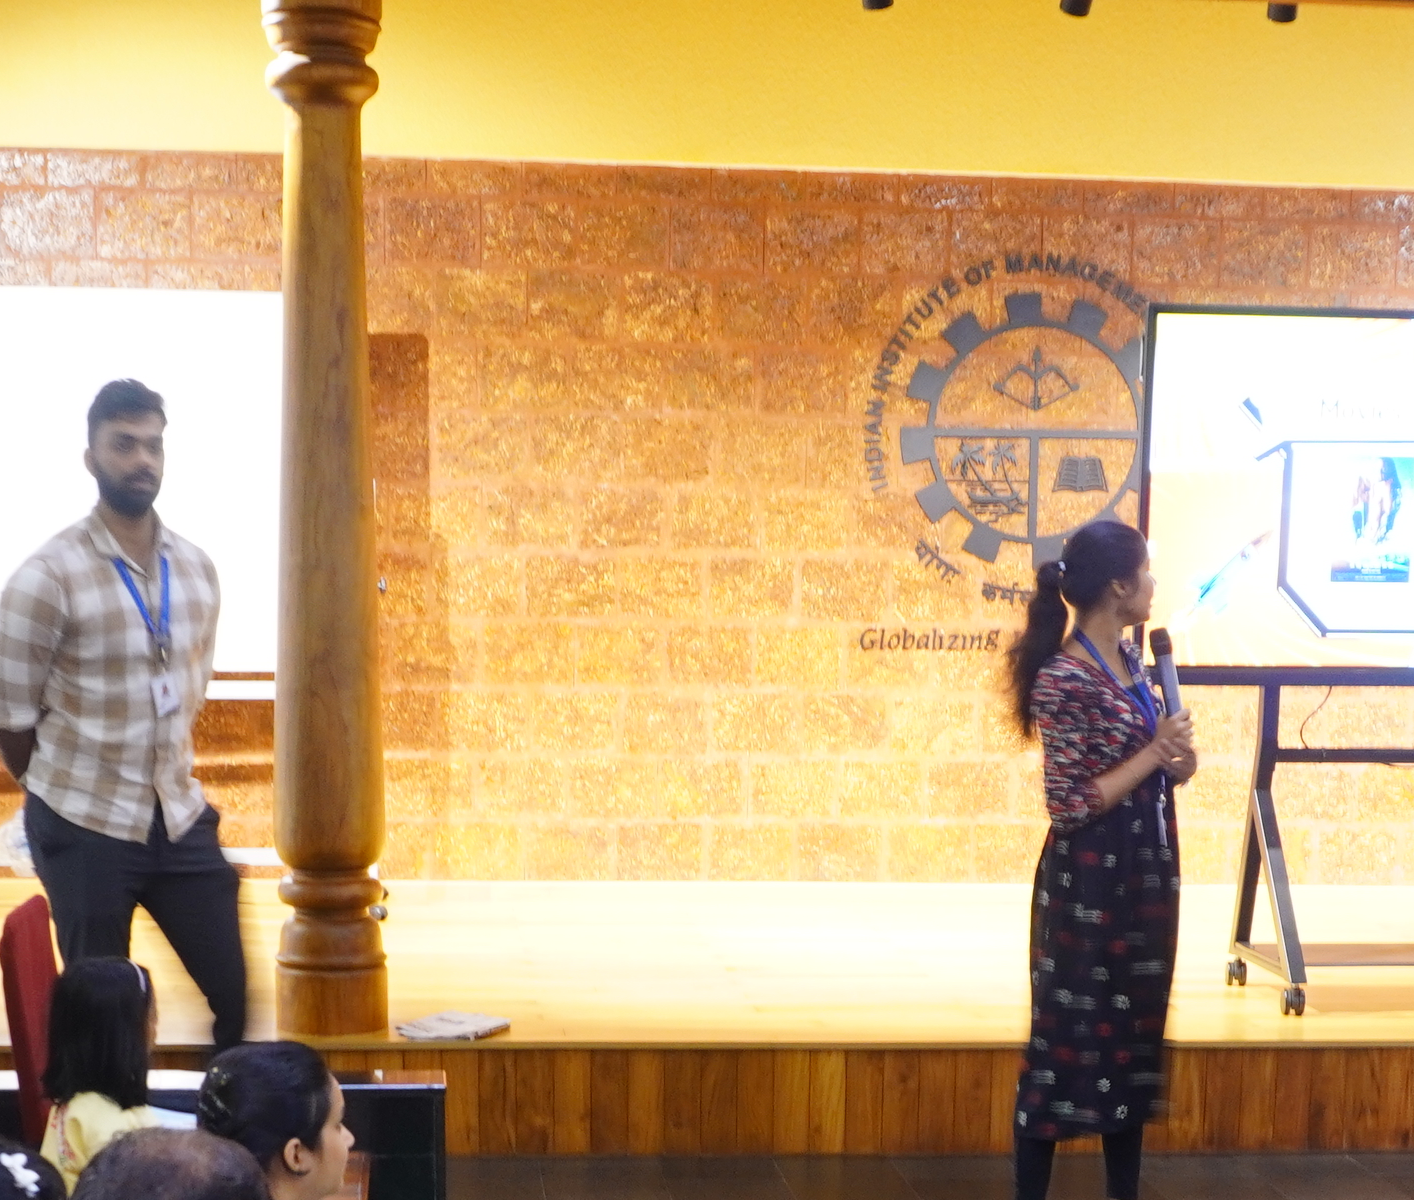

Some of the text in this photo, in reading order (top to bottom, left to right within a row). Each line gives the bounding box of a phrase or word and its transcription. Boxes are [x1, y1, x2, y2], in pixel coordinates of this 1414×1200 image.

[864, 253, 1148, 491] INDIAN INSTITUTE OF MANAGEME
[1320, 398, 1401, 420] Movie
[859, 628, 1000, 651] Globalizing
